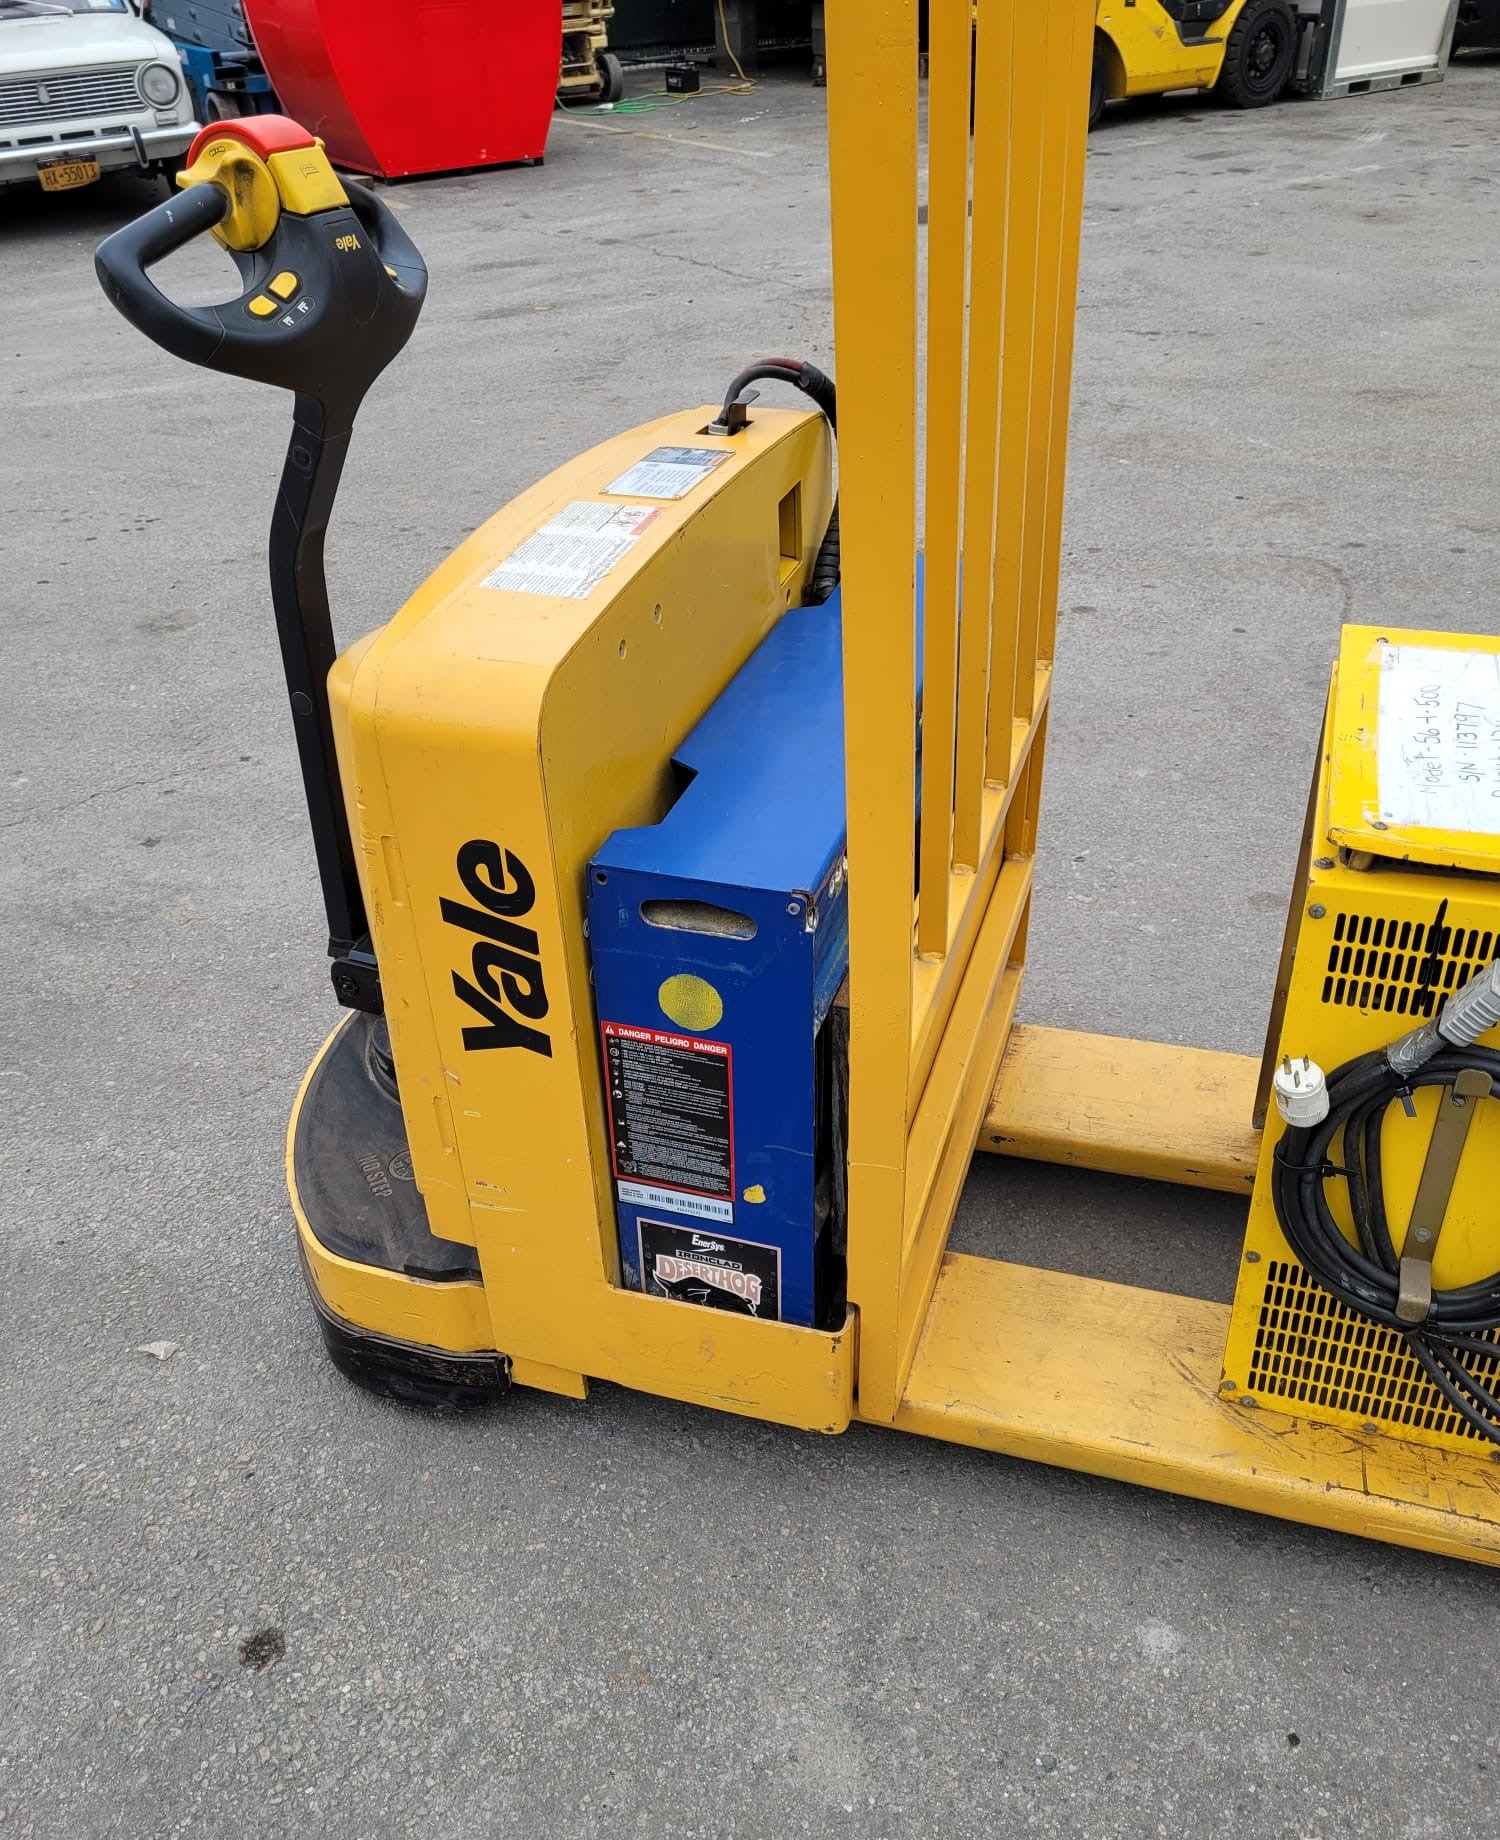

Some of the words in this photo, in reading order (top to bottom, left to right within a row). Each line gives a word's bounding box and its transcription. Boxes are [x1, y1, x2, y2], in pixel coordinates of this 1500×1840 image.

[335, 233, 361, 252] Yale
[438, 838, 553, 1059] Yale
[618, 1028, 652, 1041] DANGER
[654, 1034, 690, 1048] PELIGRO
[693, 1042, 728, 1055] DANGER
[676, 1250, 742, 1271] IRONCLAD
